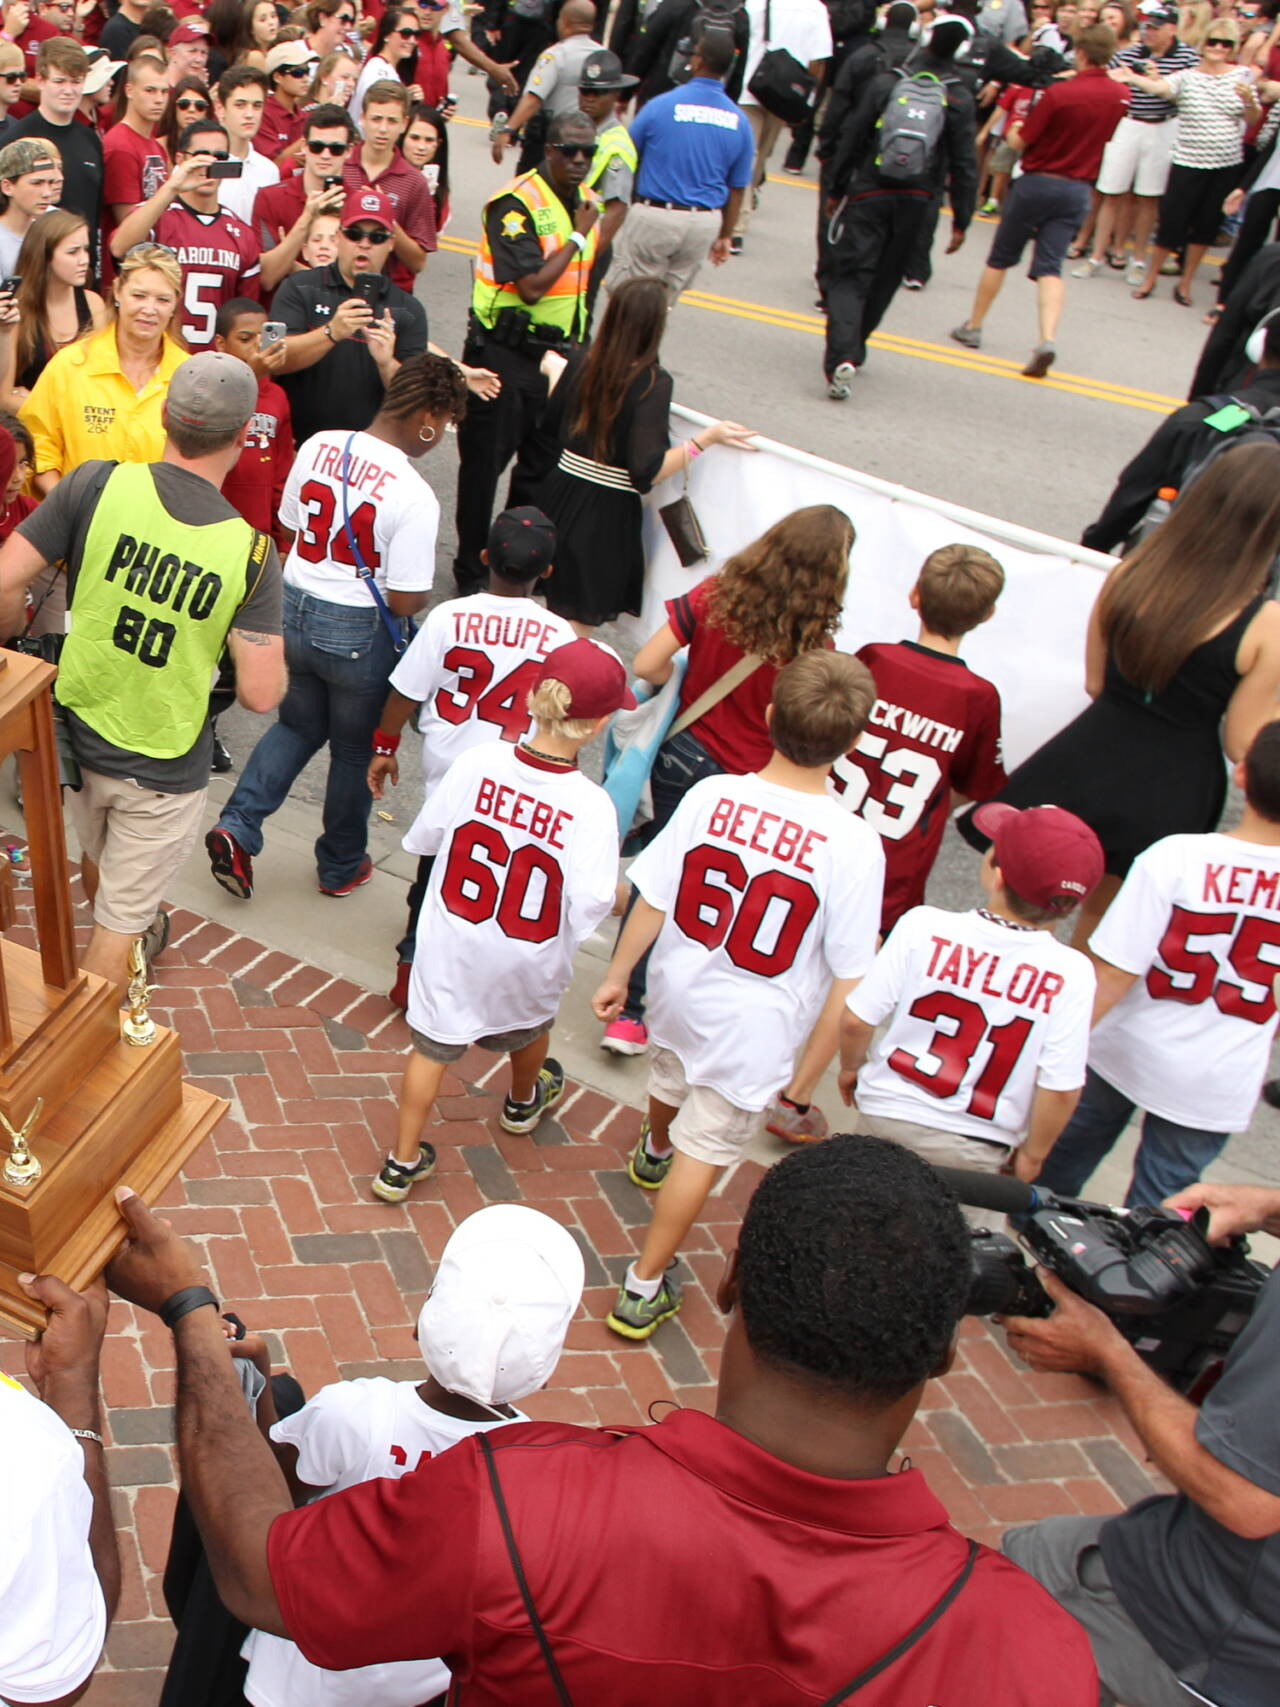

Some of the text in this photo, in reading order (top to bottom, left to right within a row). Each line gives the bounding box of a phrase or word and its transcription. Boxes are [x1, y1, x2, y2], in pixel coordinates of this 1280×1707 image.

[181, 272, 223, 344] 5
[84, 405, 116, 416] EVENT
[84, 414, 115, 424] STAFF
[312, 443, 397, 502] TROUPE
[297, 479, 381, 579] 34
[104, 533, 223, 621] PHOTO
[113, 605, 177, 668] 80
[452, 612, 559, 656] TROUPE
[434, 645, 542, 744] 34
[868, 699, 965, 753] CKWITH
[475, 777, 574, 850] BEEBE
[824, 731, 942, 841] 53
[707, 797, 828, 874] BEEBE
[440, 819, 564, 944] 60
[673, 843, 820, 978] 60
[1202, 862, 1280, 911] KEM
[925, 935, 1064, 1014] TAYLOR
[1146, 905, 1280, 1025] 55
[887, 990, 1035, 1120] 31
